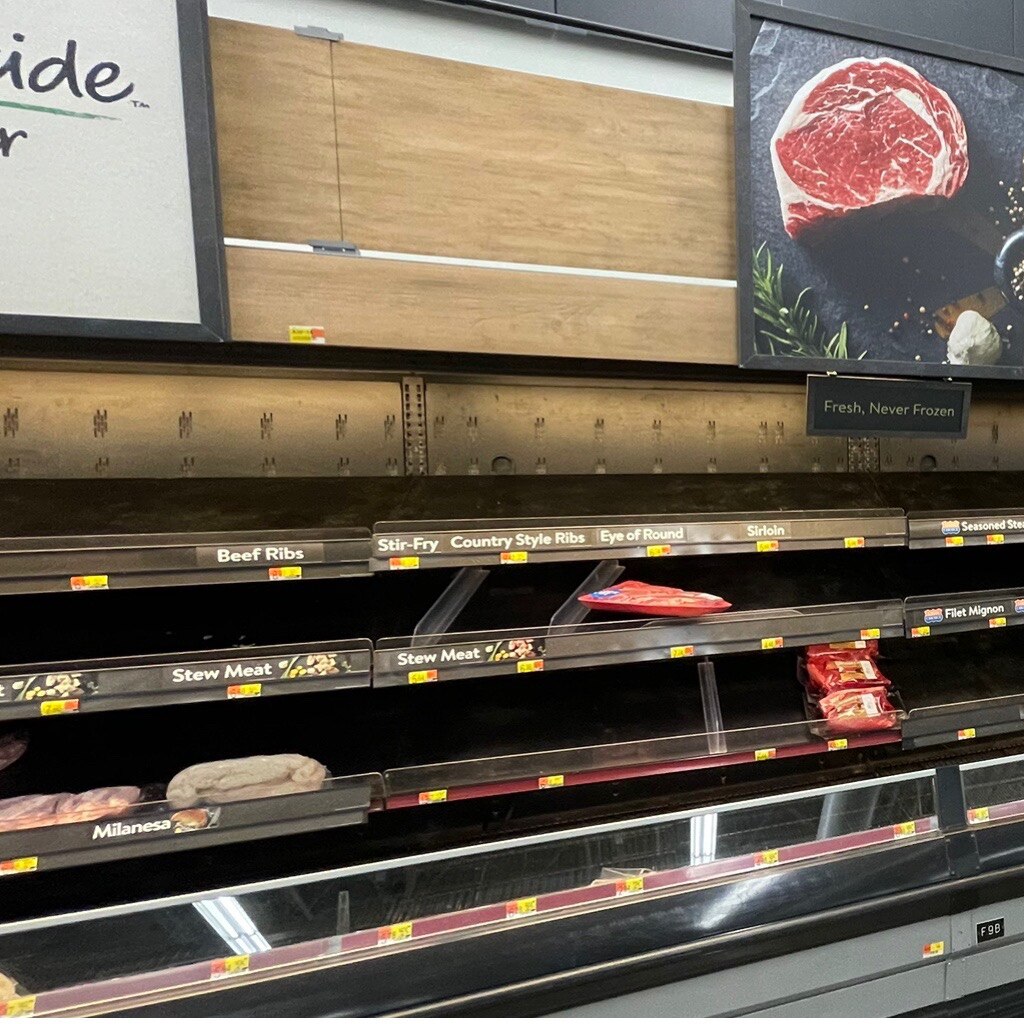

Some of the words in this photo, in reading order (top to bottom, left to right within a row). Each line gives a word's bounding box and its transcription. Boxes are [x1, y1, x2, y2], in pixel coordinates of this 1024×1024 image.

[824, 400, 865, 415] Fresh,
[870, 402, 909, 416] Never
[913, 403, 955, 417] Frozen
[747, 525, 785, 537] Sirloin
[961, 519, 1005, 532] Seasoned
[450, 534, 512, 553] Country
[516, 533, 552, 551] Style
[555, 531, 585, 544] Ribs
[600, 530, 625, 545] Eye
[627, 528, 641, 540] of
[643, 527, 684, 540] Round
[377, 537, 439, 553] Stir-Fry
[217, 548, 261, 563] Beef
[265, 546, 304, 561] Ribs
[945, 607, 967, 619] Filet
[969, 603, 1004, 617] Mignon
[397, 652, 436, 665] Stew
[440, 648, 480, 662] Meat
[172, 667, 219, 683] Stew
[225, 663, 272, 680] Meat
[92, 818, 171, 840] Milanesa
